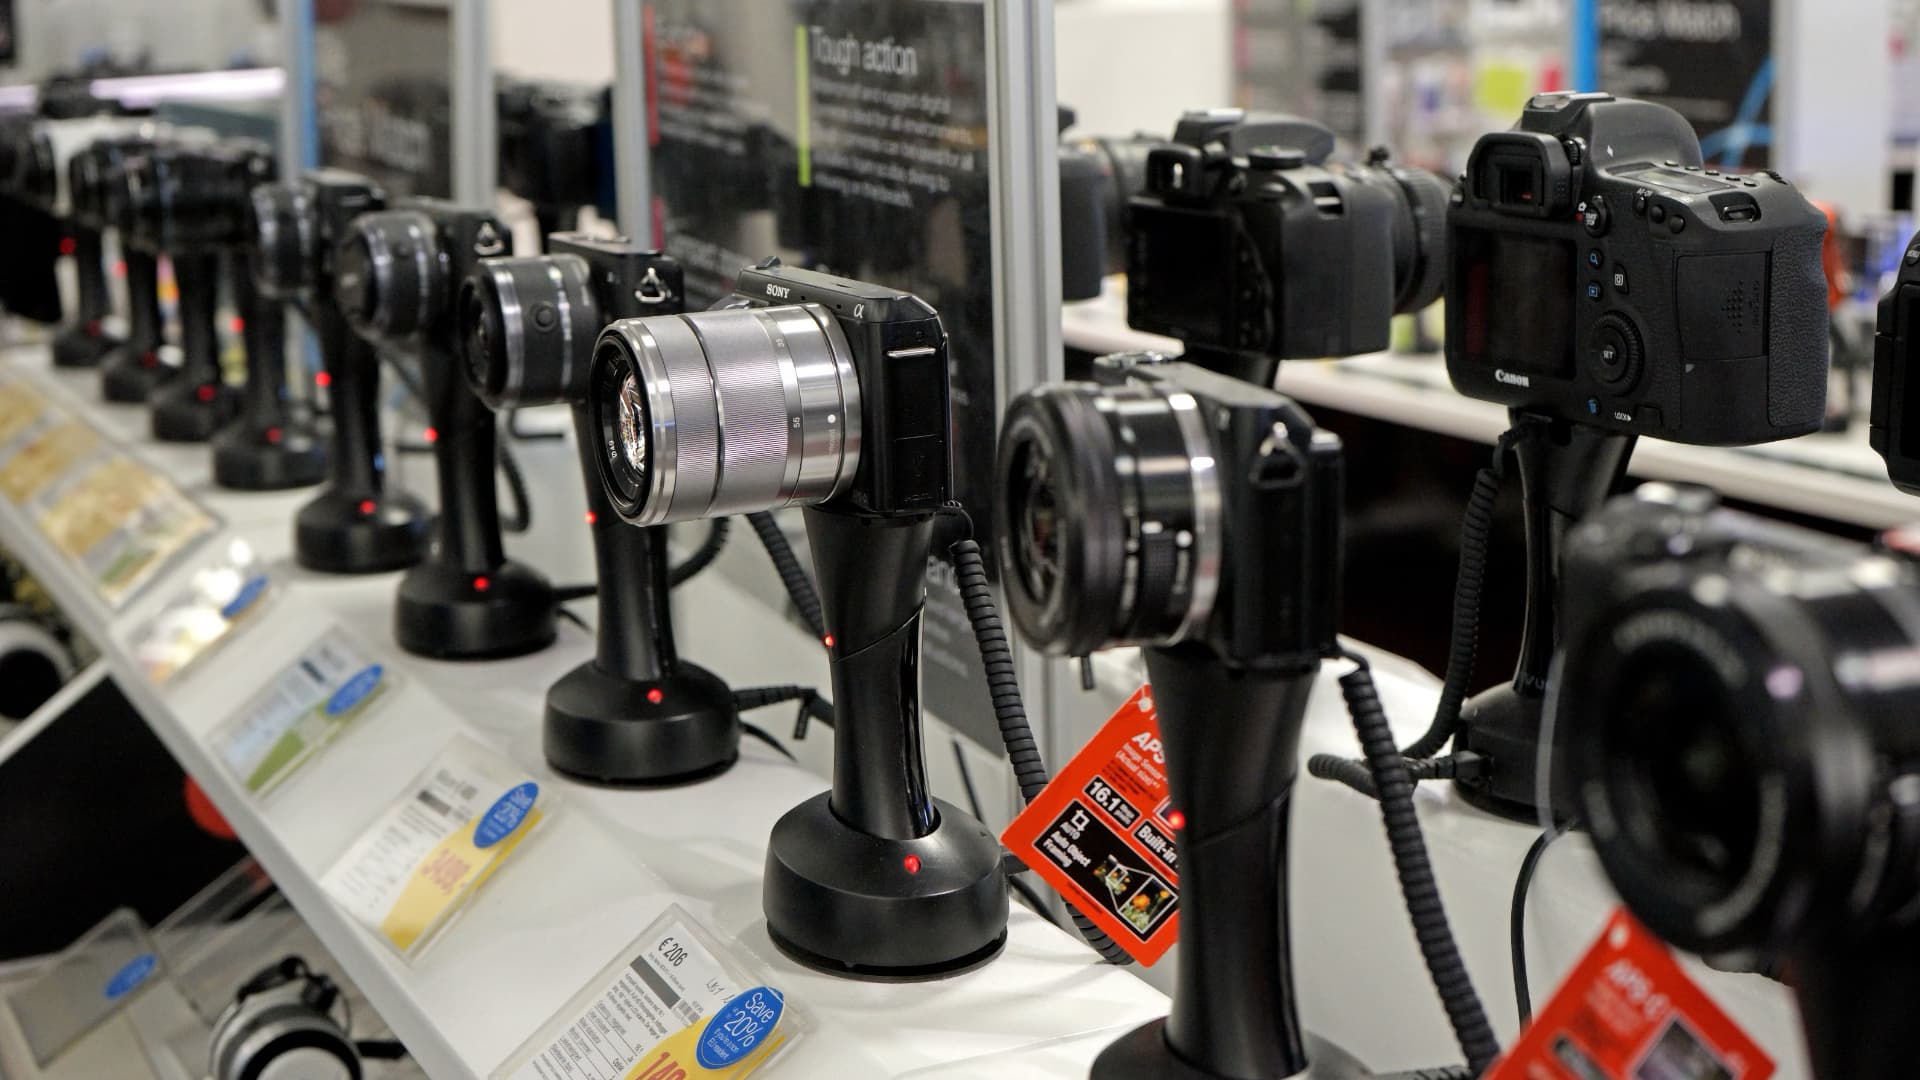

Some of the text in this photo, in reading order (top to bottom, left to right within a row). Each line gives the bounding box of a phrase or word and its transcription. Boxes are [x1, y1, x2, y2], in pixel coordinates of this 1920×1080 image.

[811, 25, 918, 76] Tough action
[766, 283, 790, 299] SONY
[1603, 350, 1614, 359] SET
[1495, 369, 1530, 388] Canon
[1089, 780, 1122, 812] 16.1
[1041, 837, 1074, 869] Framing
[1050, 830, 1091, 868] Auto Object
[1137, 825, 1178, 864] Built-in
[658, 936, 674, 952] €
[663, 943, 688, 967] 206
[745, 991, 775, 1024] Save
[723, 1010, 763, 1048] 20%
